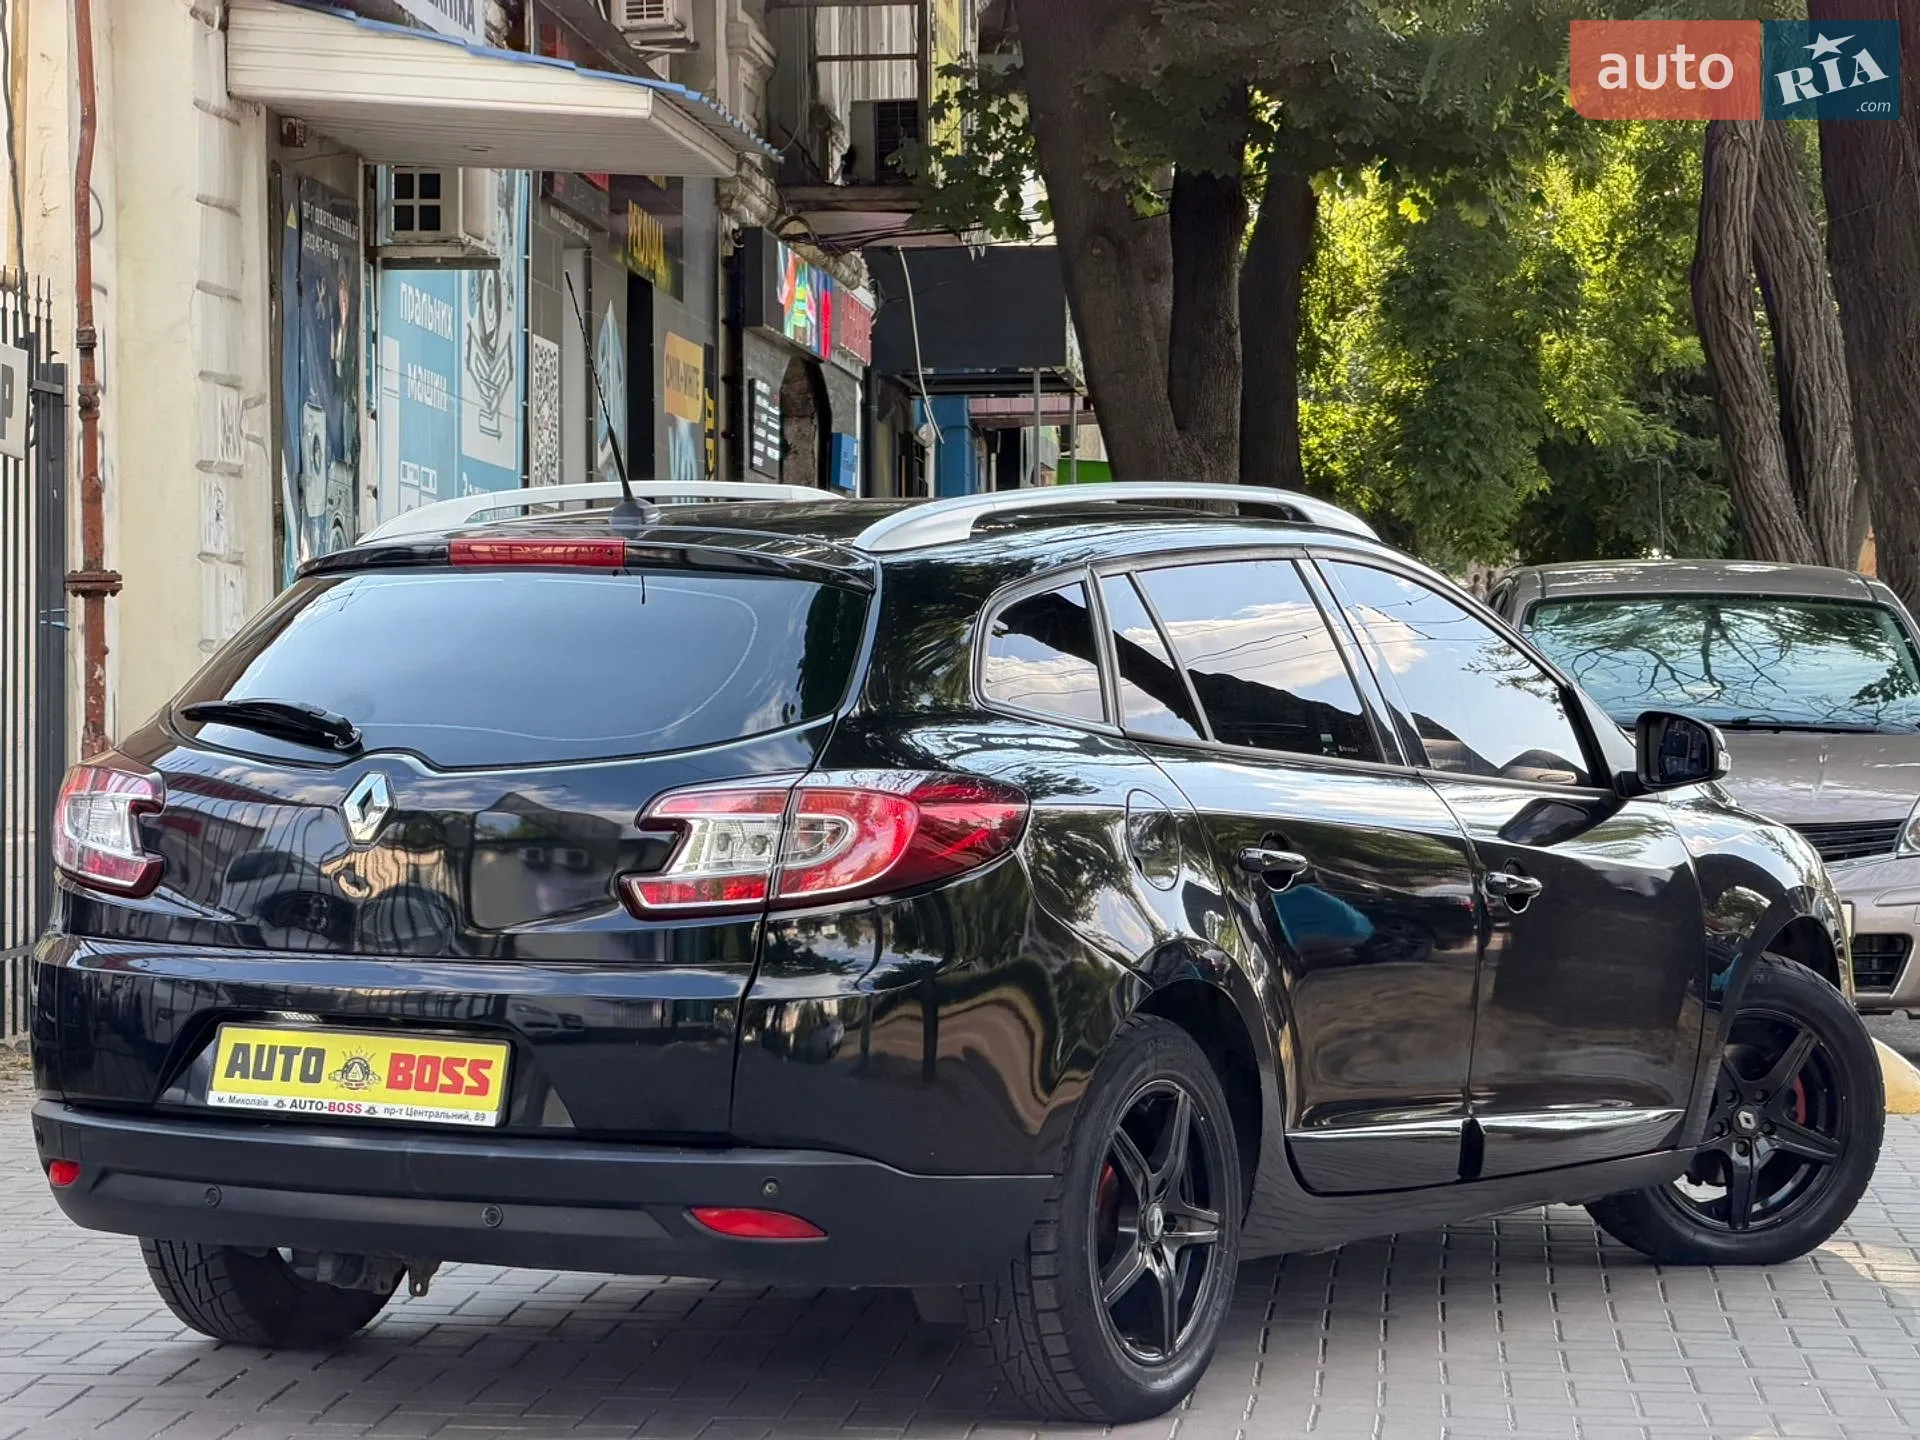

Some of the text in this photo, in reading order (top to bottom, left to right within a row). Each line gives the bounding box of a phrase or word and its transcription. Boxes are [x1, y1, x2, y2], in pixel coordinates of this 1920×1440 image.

[400, 282, 454, 340] пральних
[407, 363, 447, 412] машин
[224, 1042, 493, 1097] AUTO BOSS
[228, 1095, 269, 1107] Миколаїв
[289, 1098, 362, 1114] AUTO-BOSS
[383, 1105, 487, 1122] пр-т Центральний, 89
